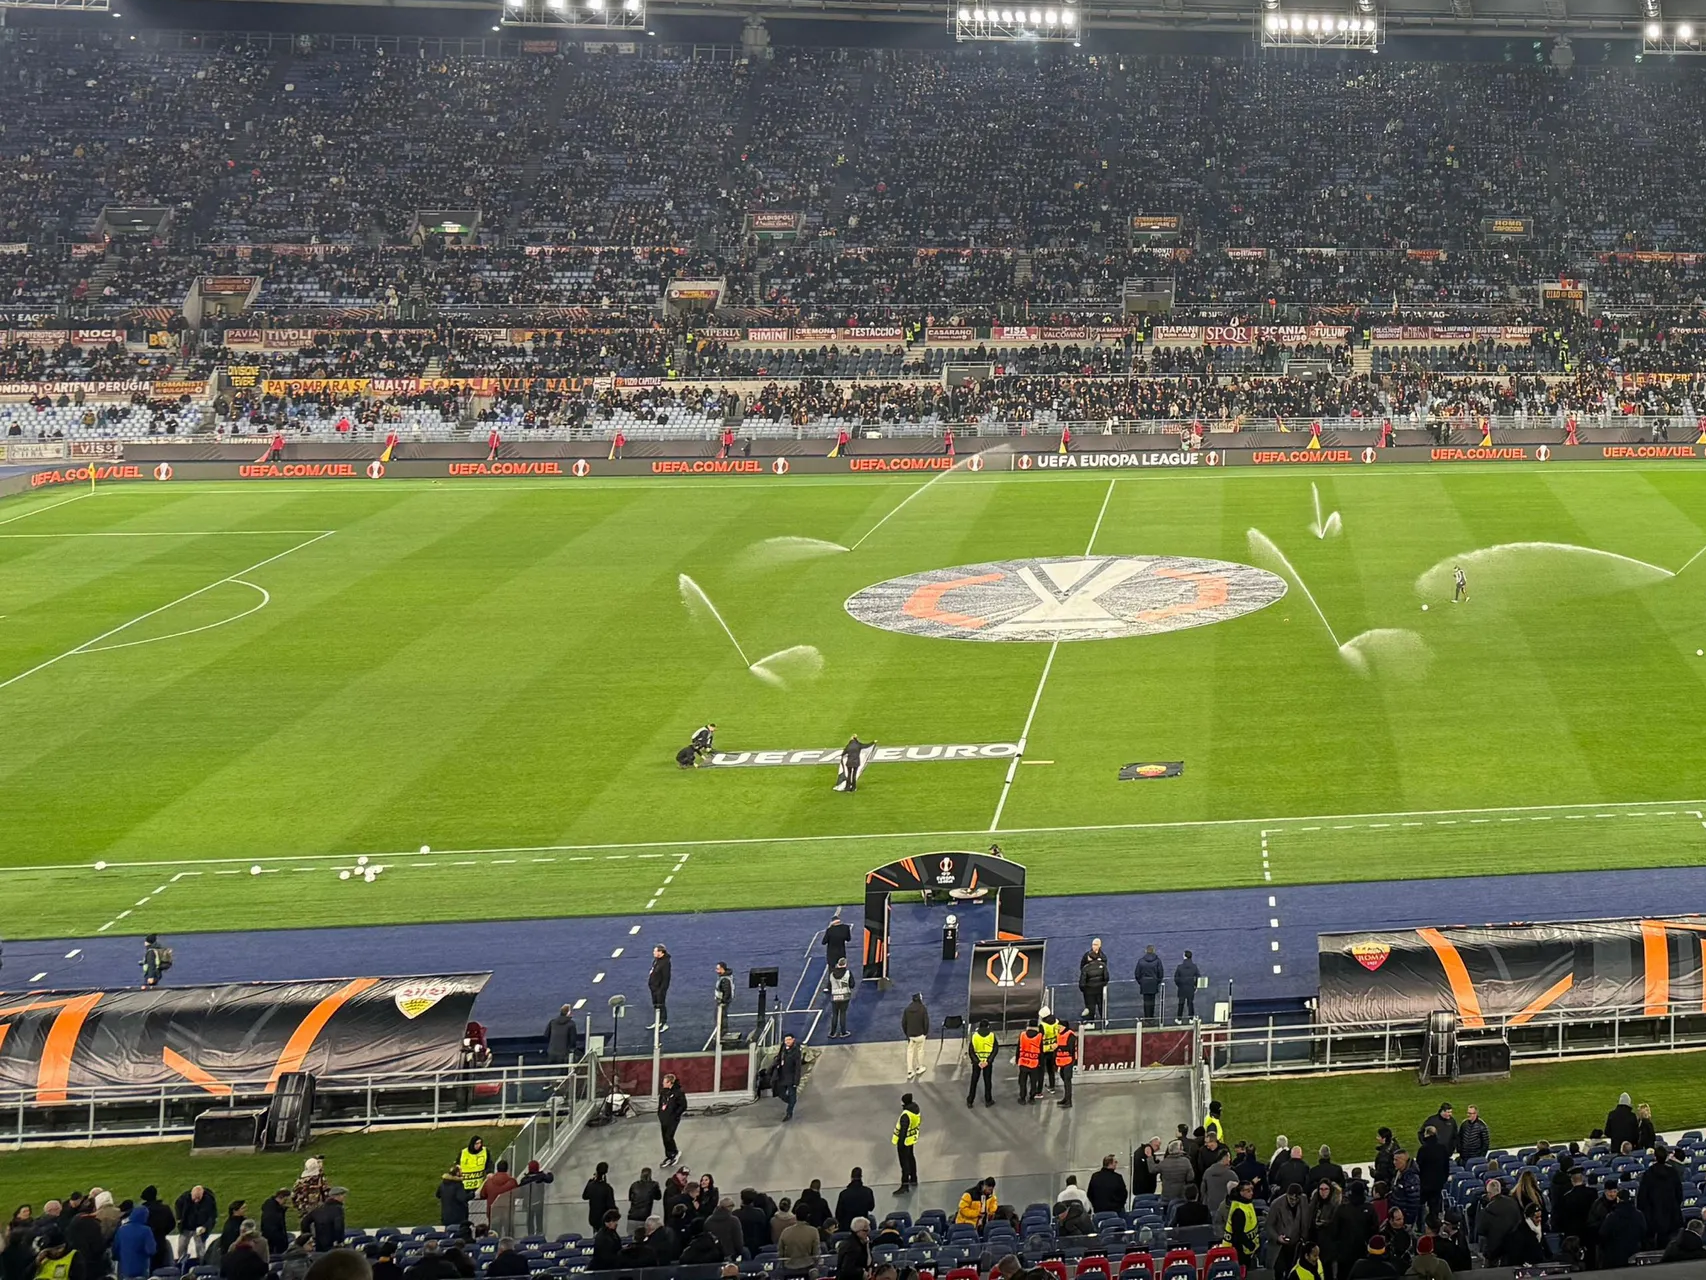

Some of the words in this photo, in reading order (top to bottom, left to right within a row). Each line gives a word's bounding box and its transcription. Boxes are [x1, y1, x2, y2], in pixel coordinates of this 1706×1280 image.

[79, 329, 117, 338] NOCI
[228, 330, 259, 338] PAVIA
[267, 329, 312, 340] TIVOLI
[749, 331, 787, 341] RIMINI
[795, 327, 836, 335] CREMONA
[850, 327, 895, 337] TESTACCIO
[1003, 326, 1027, 335] PISA
[1157, 326, 1199, 334] TRAPANI
[1206, 326, 1249, 341] SPQR
[1314, 327, 1347, 337] TULUM
[98, 380, 150, 392] PERUGIA
[373, 379, 417, 391] MALTA
[1252, 450, 1353, 464] UEFA.COM/UEL
[1430, 448, 1527, 461] UEFA.COM/UEL
[1603, 446, 1696, 458] UEFA.COM/UEL
[849, 458, 957, 471] UEFA.COM/UEL
[1038, 455, 1079, 468] UEFA
[1082, 454, 1139, 468] EUROPA
[1142, 452, 1199, 467] LEAGUE
[239, 464, 357, 478] UEFA.COM/UEL
[448, 462, 563, 476] UEFA.COM/UEL
[652, 460, 763, 474] UEFA.COM/UEL
[873, 743, 1019, 761] EURO
